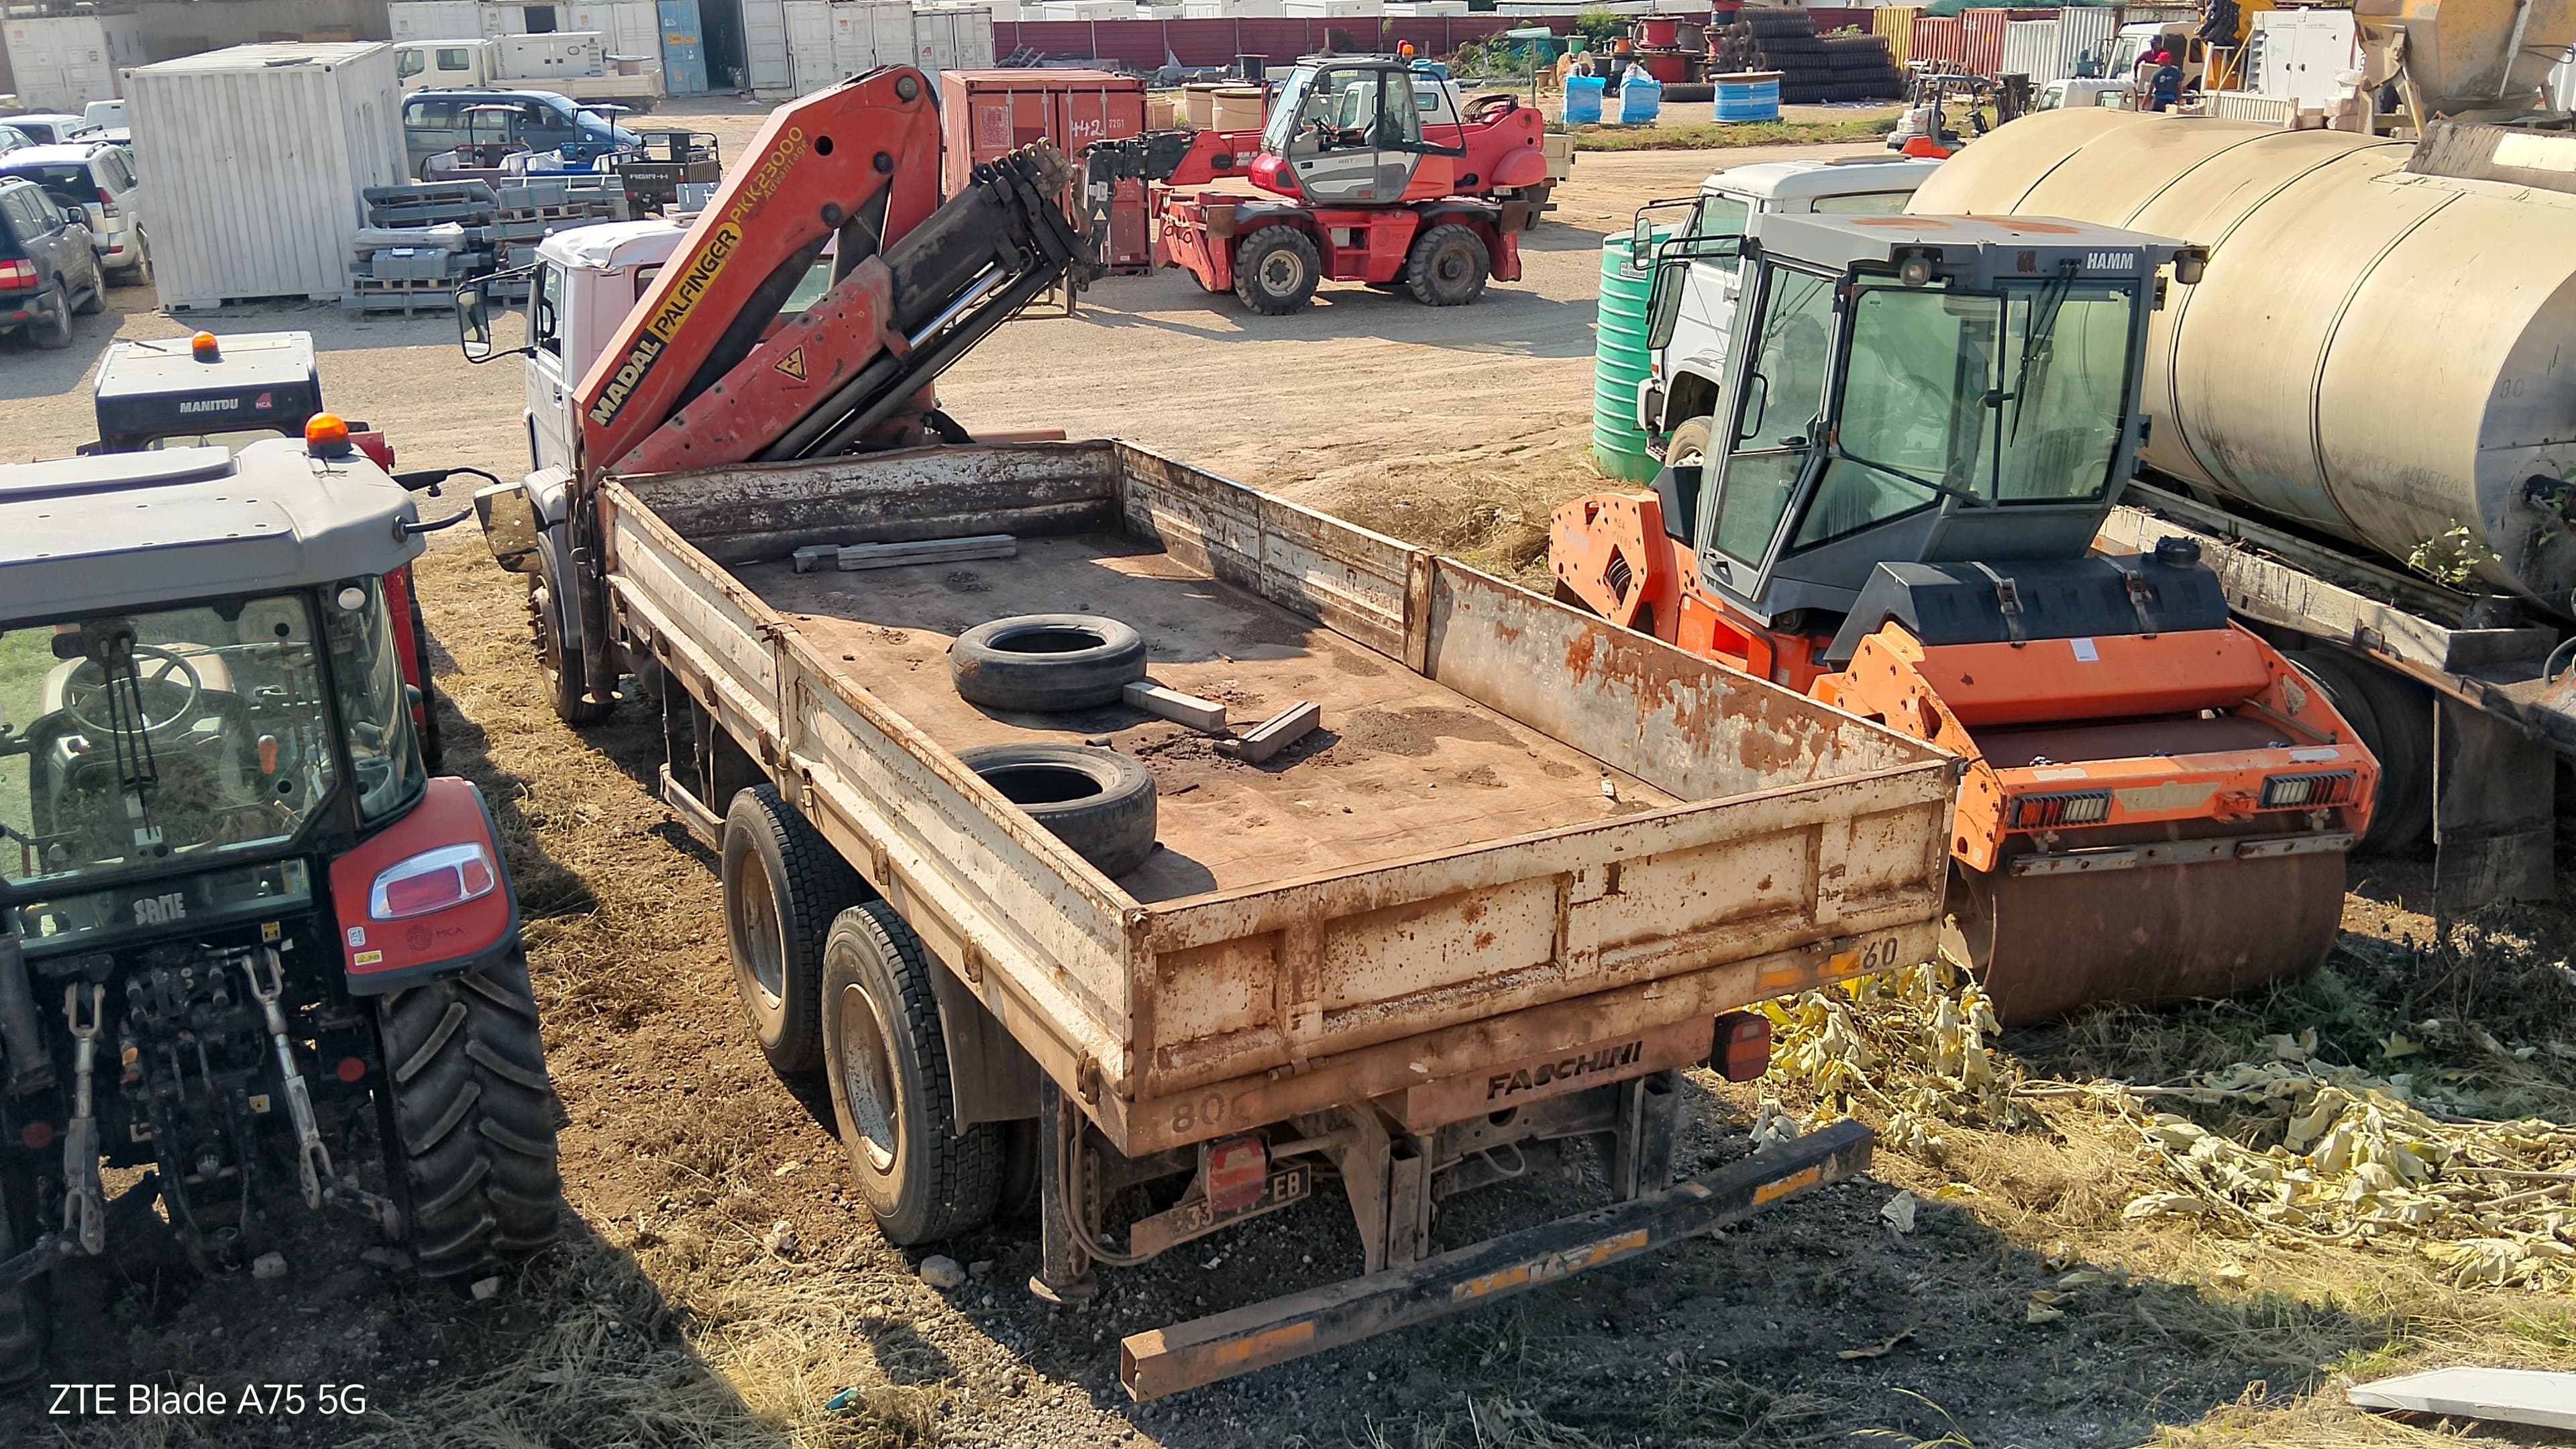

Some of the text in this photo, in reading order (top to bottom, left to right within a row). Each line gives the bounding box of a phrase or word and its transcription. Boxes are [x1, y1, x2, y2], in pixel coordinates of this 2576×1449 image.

[764, 140, 808, 201] Advantage
[2086, 252, 2134, 269] HAMM
[654, 229, 737, 337] PALFINGER
[589, 339, 661, 426] MADAL
[180, 398, 239, 413] MANITOU
[133, 892, 186, 925] SAME
[437, 926, 463, 938] MCA
[1863, 937, 1898, 969] 60
